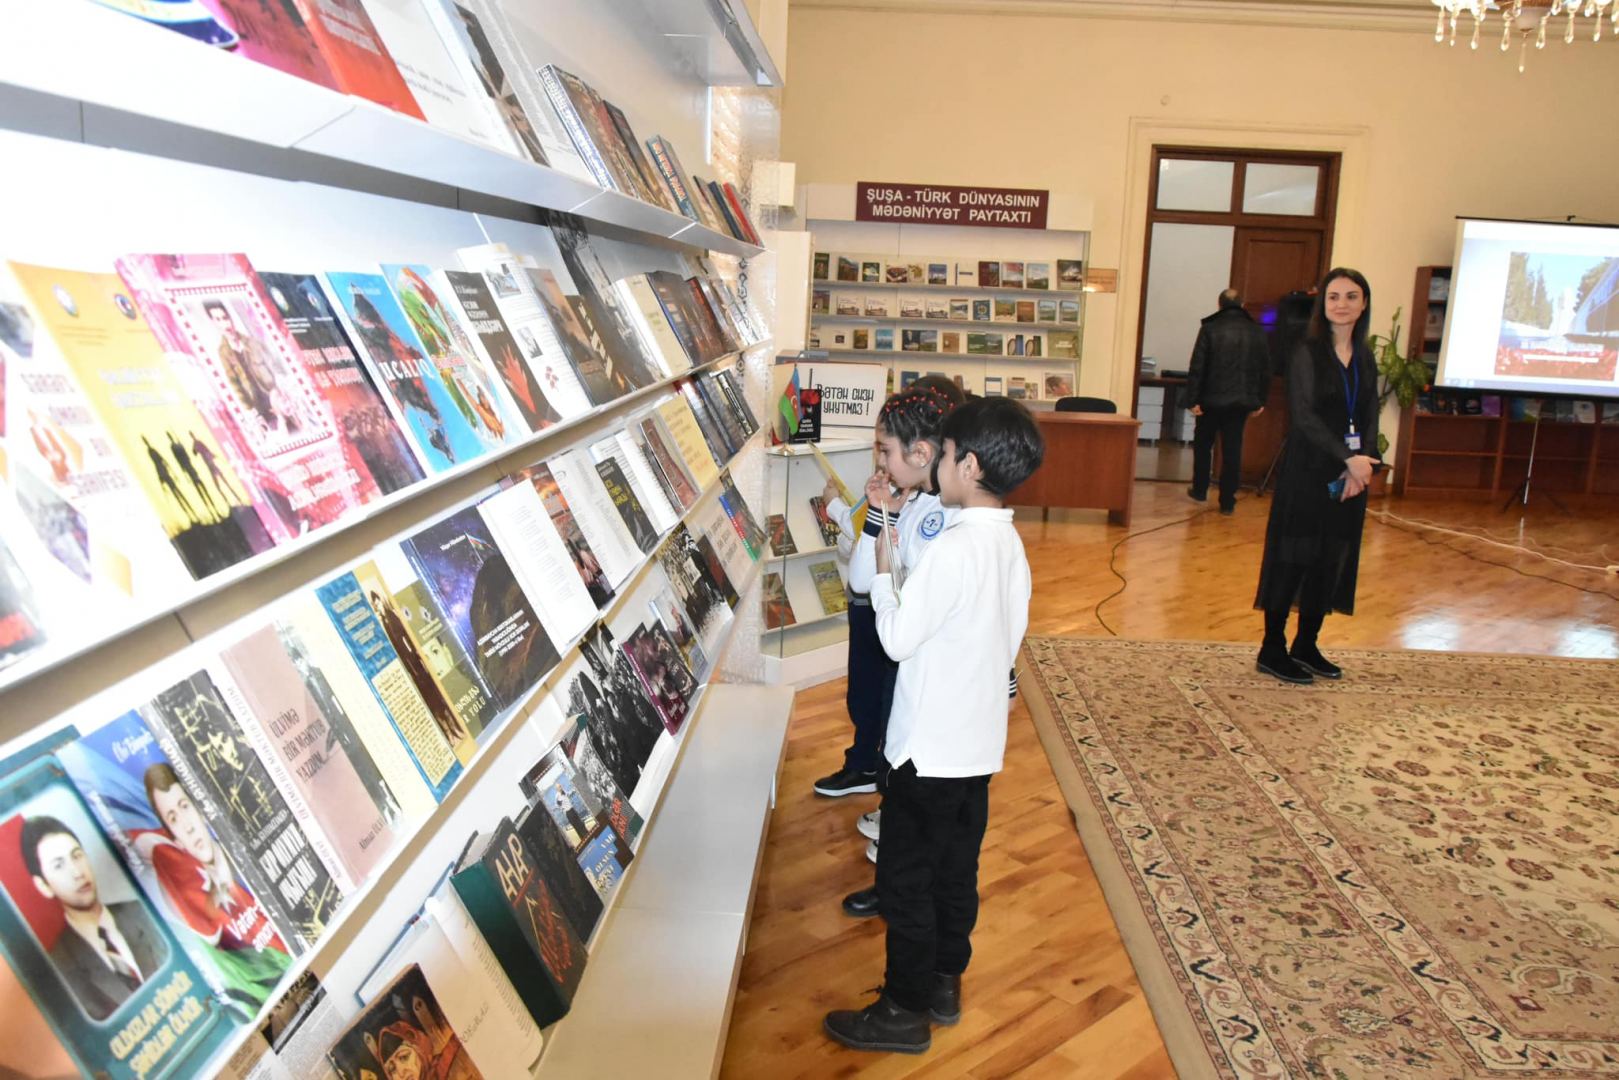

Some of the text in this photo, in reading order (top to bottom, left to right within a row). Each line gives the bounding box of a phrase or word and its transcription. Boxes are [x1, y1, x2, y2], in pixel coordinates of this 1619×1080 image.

[866, 188, 904, 206] ŞUŞA
[914, 188, 952, 204] TÜRK
[959, 191, 1040, 208] DÜNYASININ
[872, 204, 1032, 223] MƏDƏNİYYƏT PAYTAXTI
